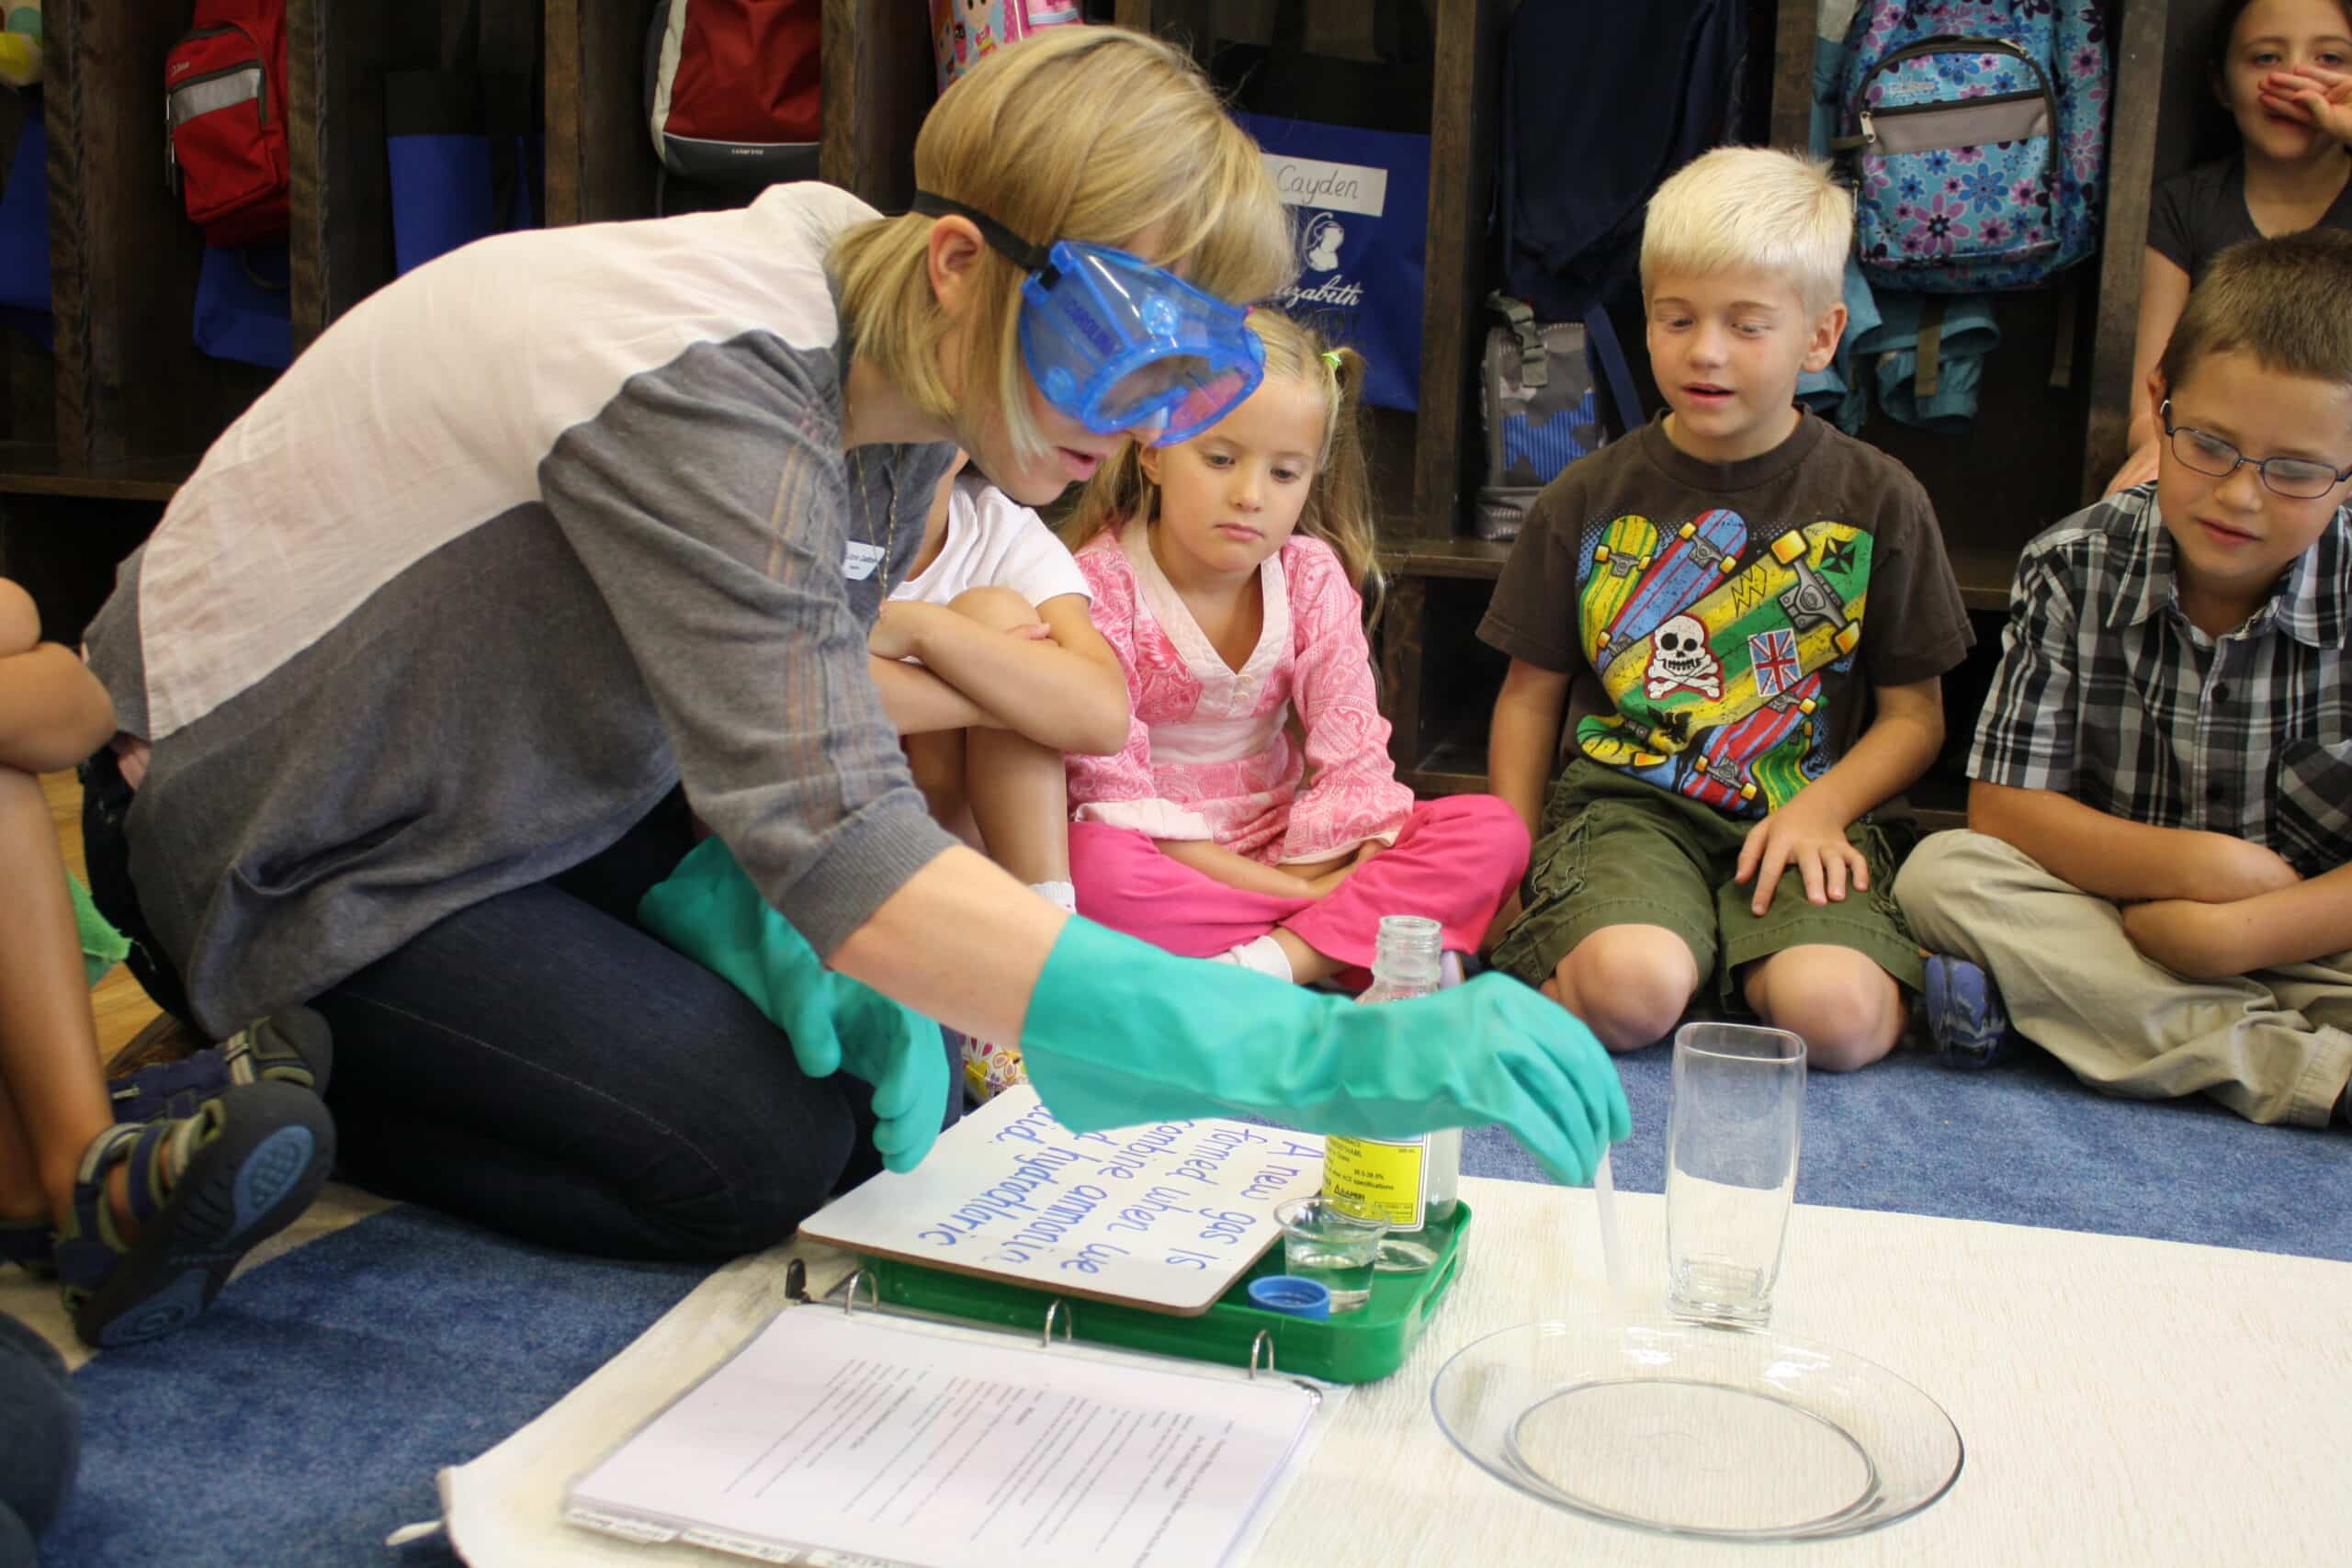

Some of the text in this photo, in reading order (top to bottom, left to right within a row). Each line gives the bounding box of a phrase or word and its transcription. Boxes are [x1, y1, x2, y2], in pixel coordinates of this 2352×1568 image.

[1277, 164, 1360, 204] Cayden
[1266, 1141, 1325, 1158] A
[919, 1145, 1102, 1247] hydrochloric
[1060, 1128, 1268, 1274] formed when we
[1240, 1164, 1301, 1200] new
[1199, 1207, 1257, 1245] gas
